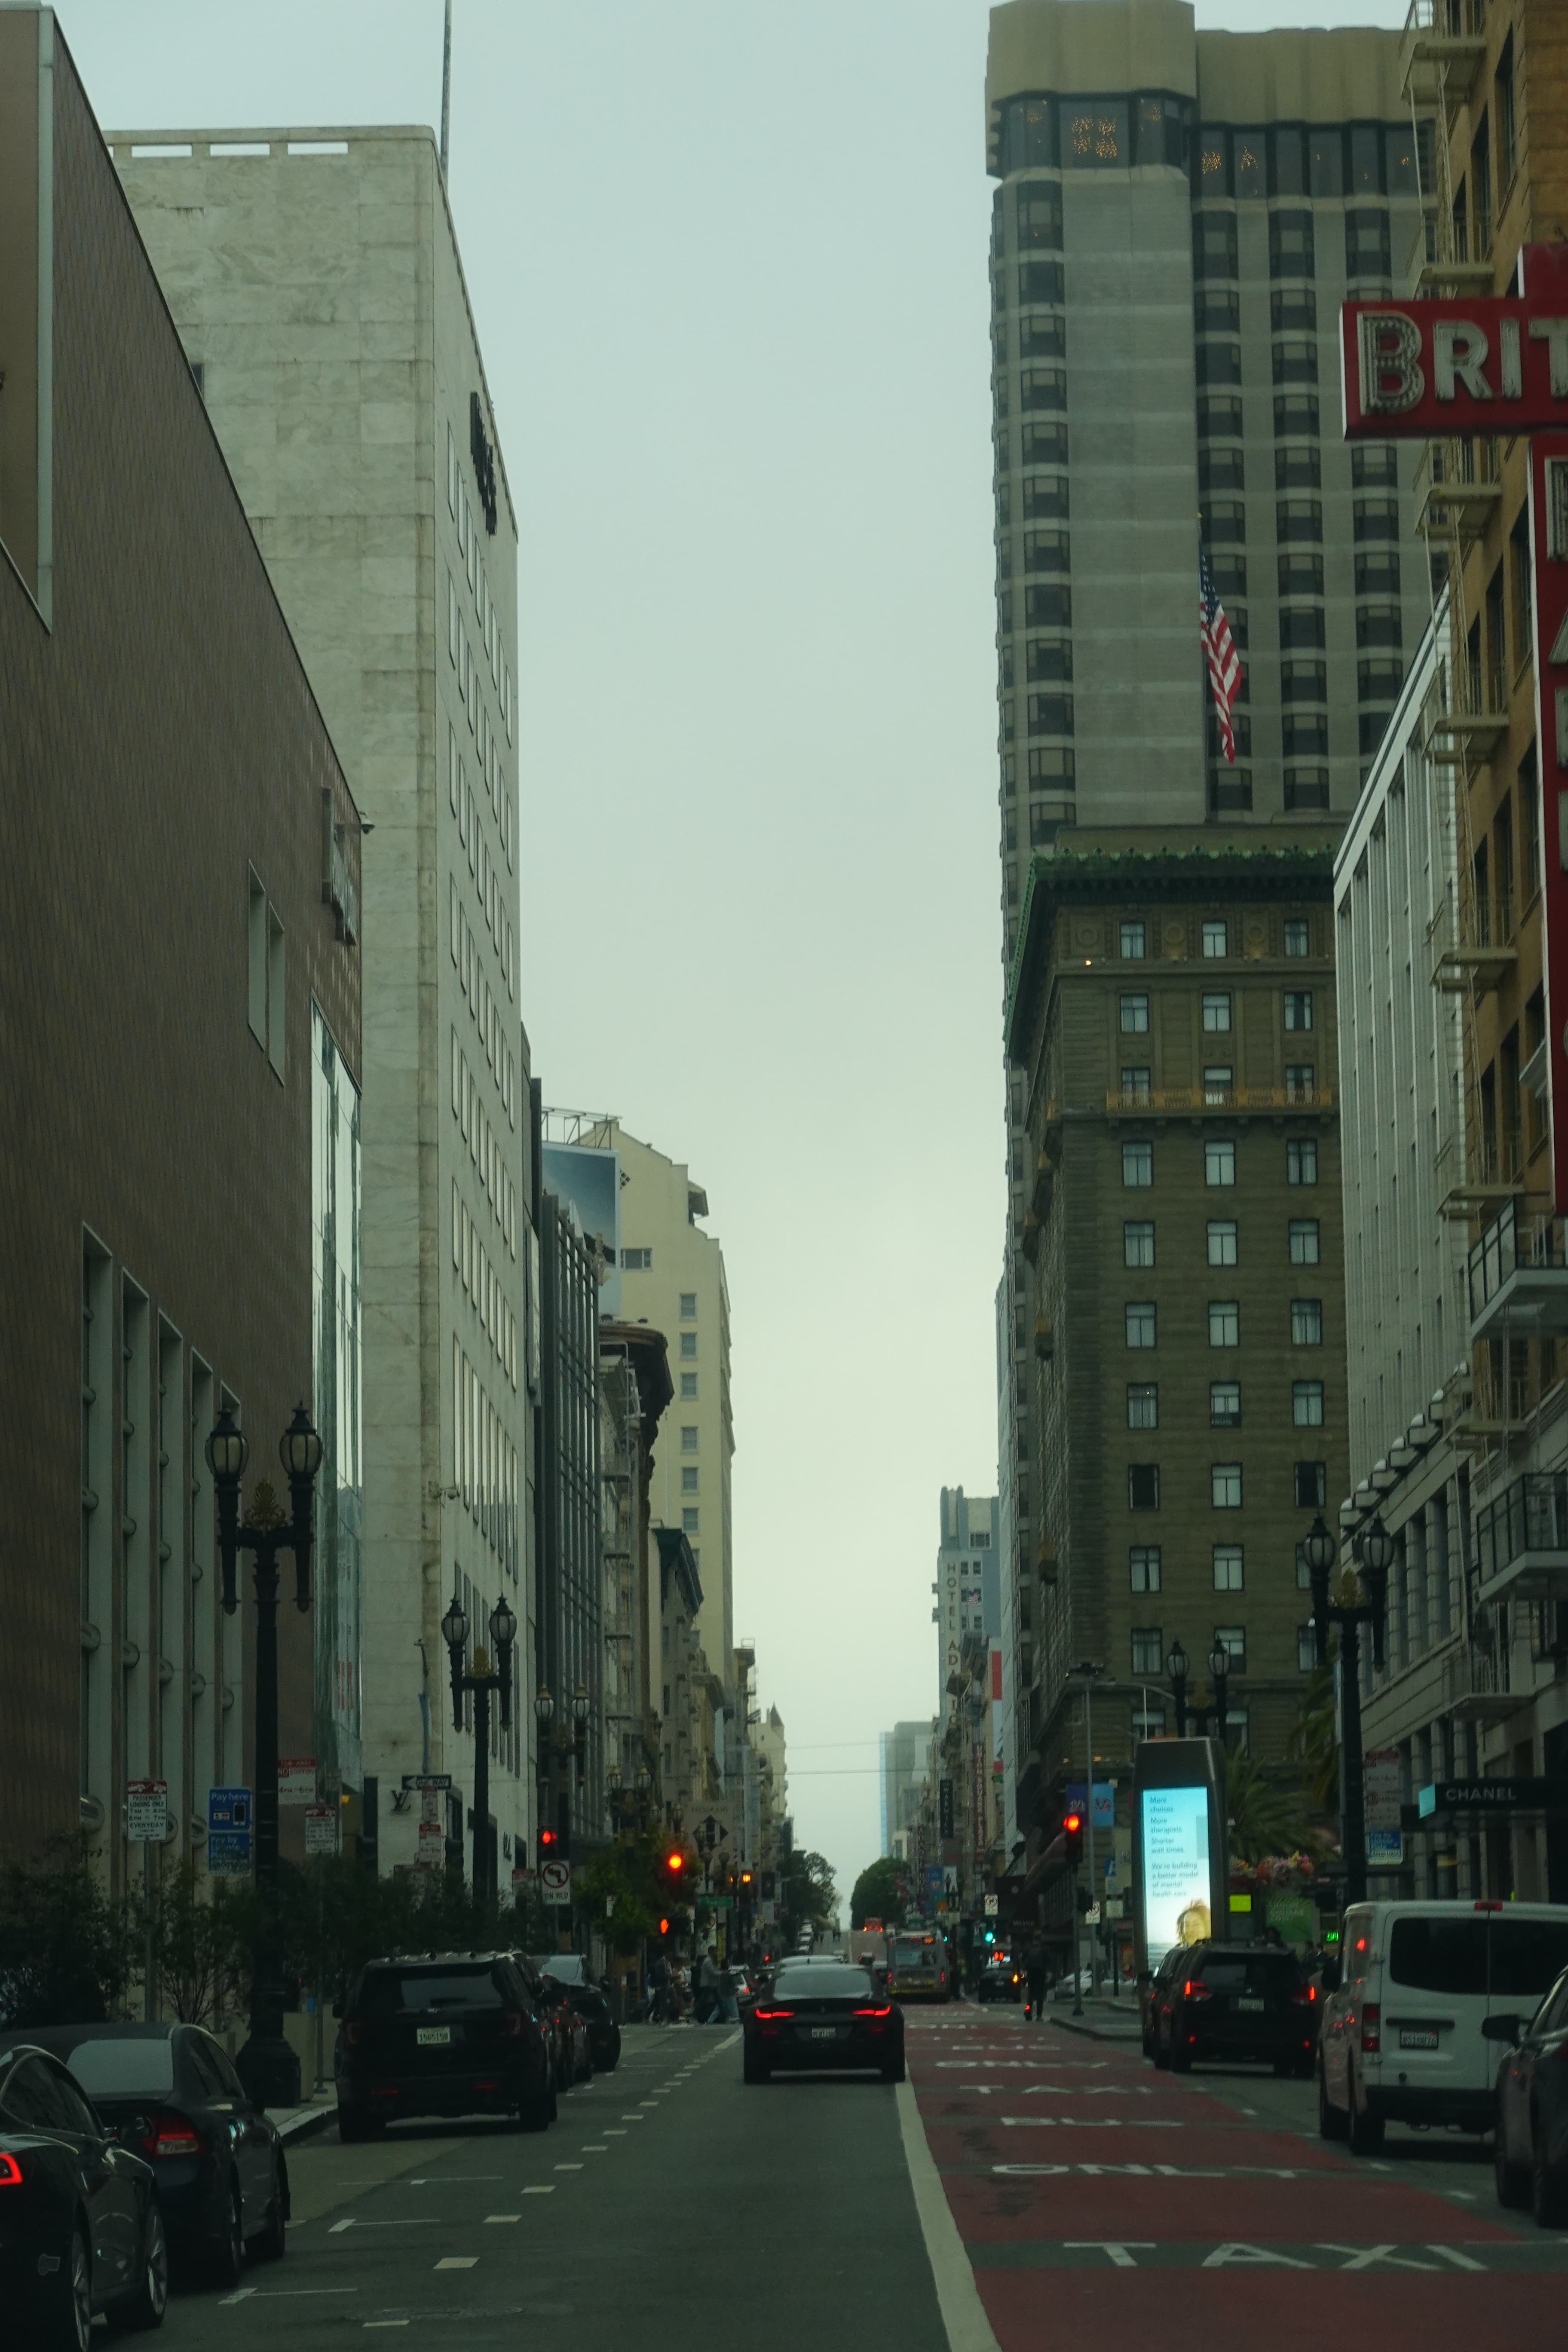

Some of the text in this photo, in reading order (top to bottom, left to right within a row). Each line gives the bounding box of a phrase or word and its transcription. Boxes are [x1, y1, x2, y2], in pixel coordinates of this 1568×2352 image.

[947, 1562, 956, 1630] HOTEL
[211, 1792, 227, 1802] Pay
[1446, 1787, 1517, 1801] CHANEL
[228, 1835, 237, 1844] by
[959, 2085, 1154, 2094] TAXI
[1001, 2116, 1184, 2127] BUS
[991, 2163, 1309, 2178] ONLY
[1062, 2242, 1491, 2271] TAXI
